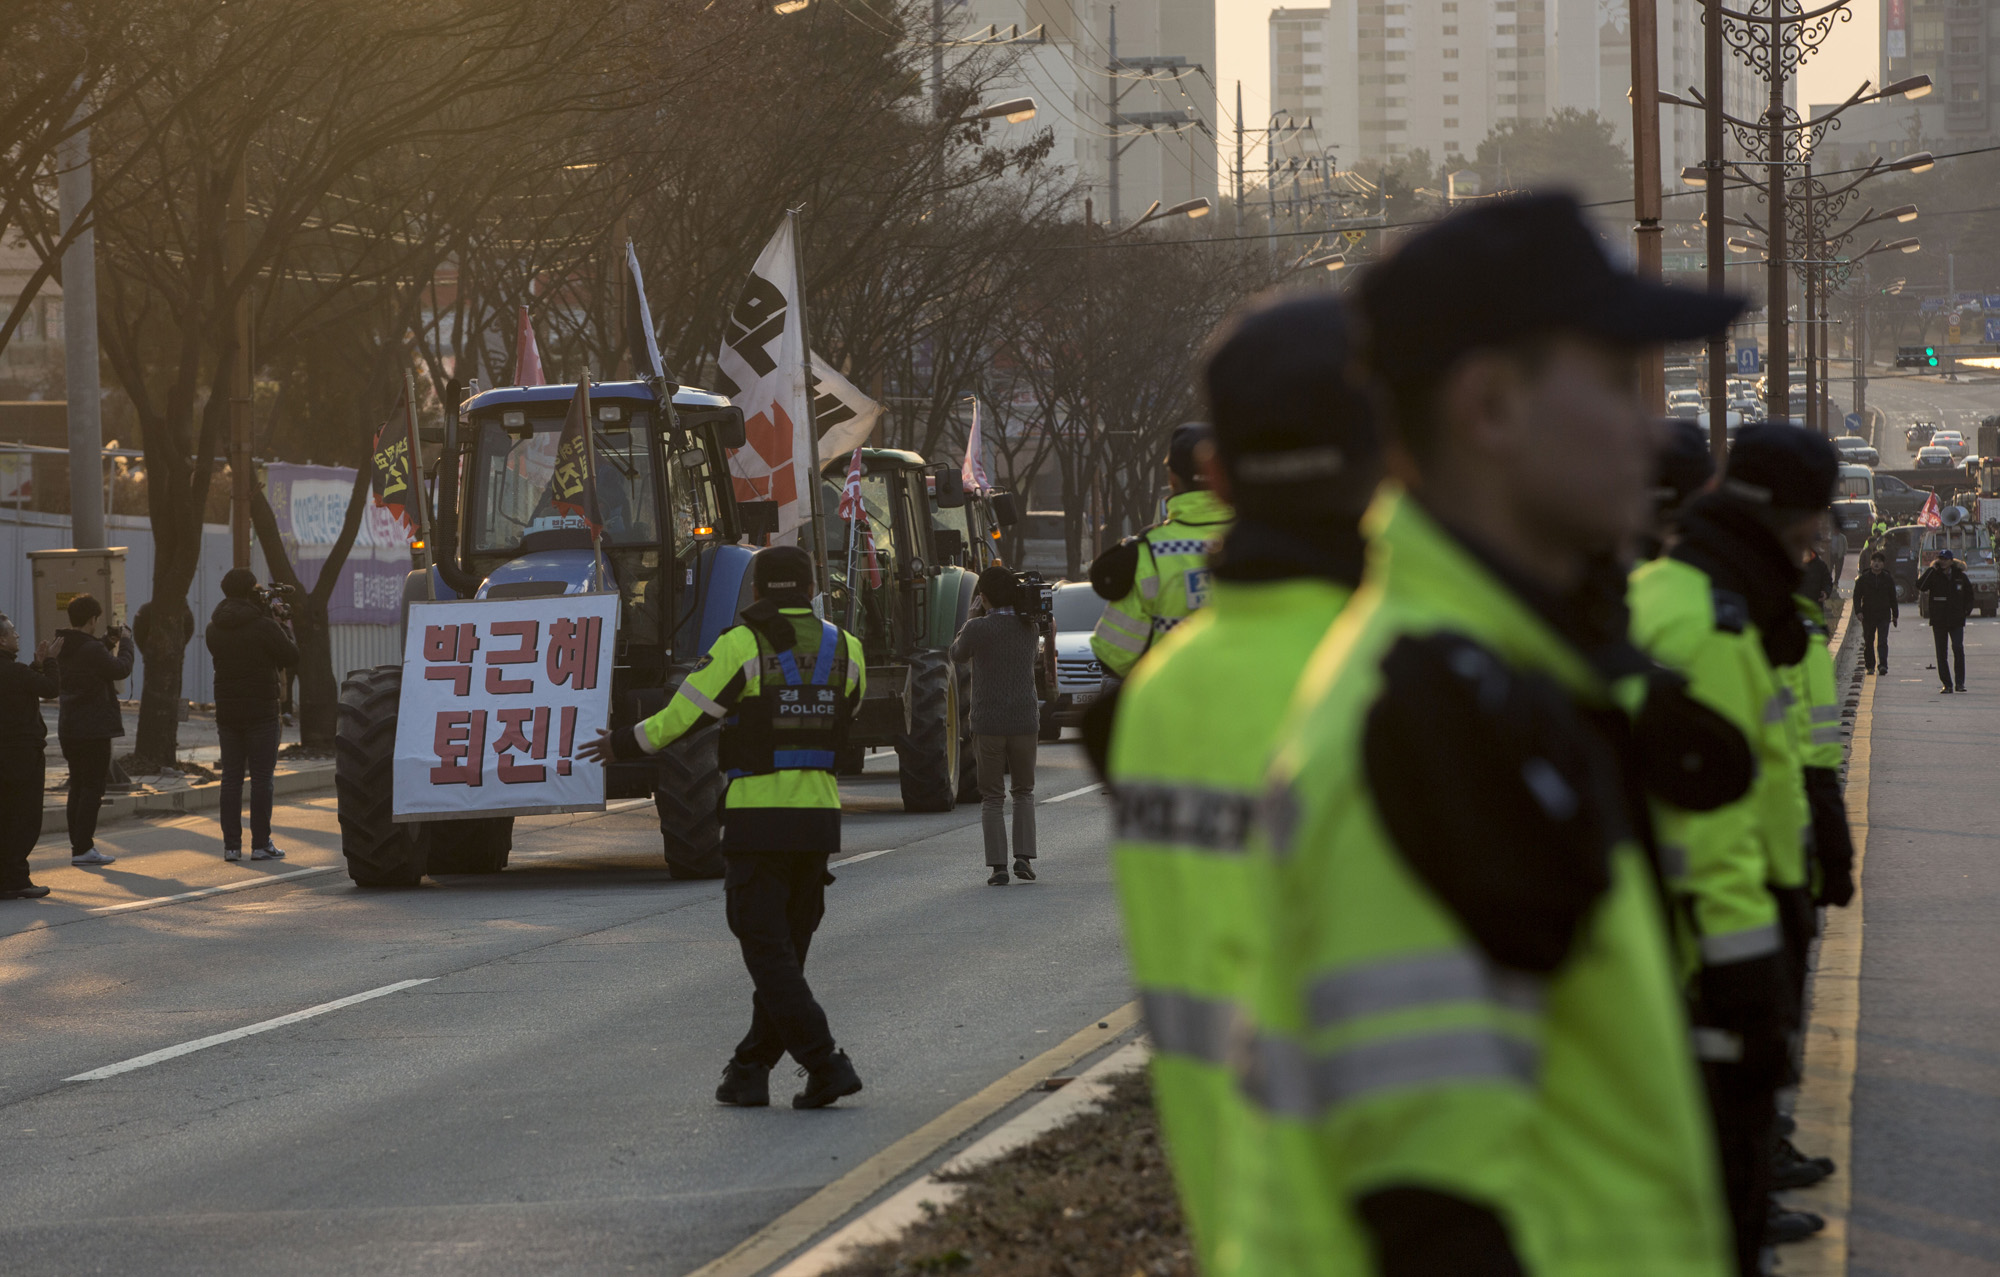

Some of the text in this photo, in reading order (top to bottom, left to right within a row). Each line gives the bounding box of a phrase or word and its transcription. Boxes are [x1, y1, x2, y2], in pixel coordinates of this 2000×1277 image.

[423, 616, 602, 697] 박근혜
[430, 706, 578, 787] 퇴진!
[780, 704, 835, 715] POLICE
